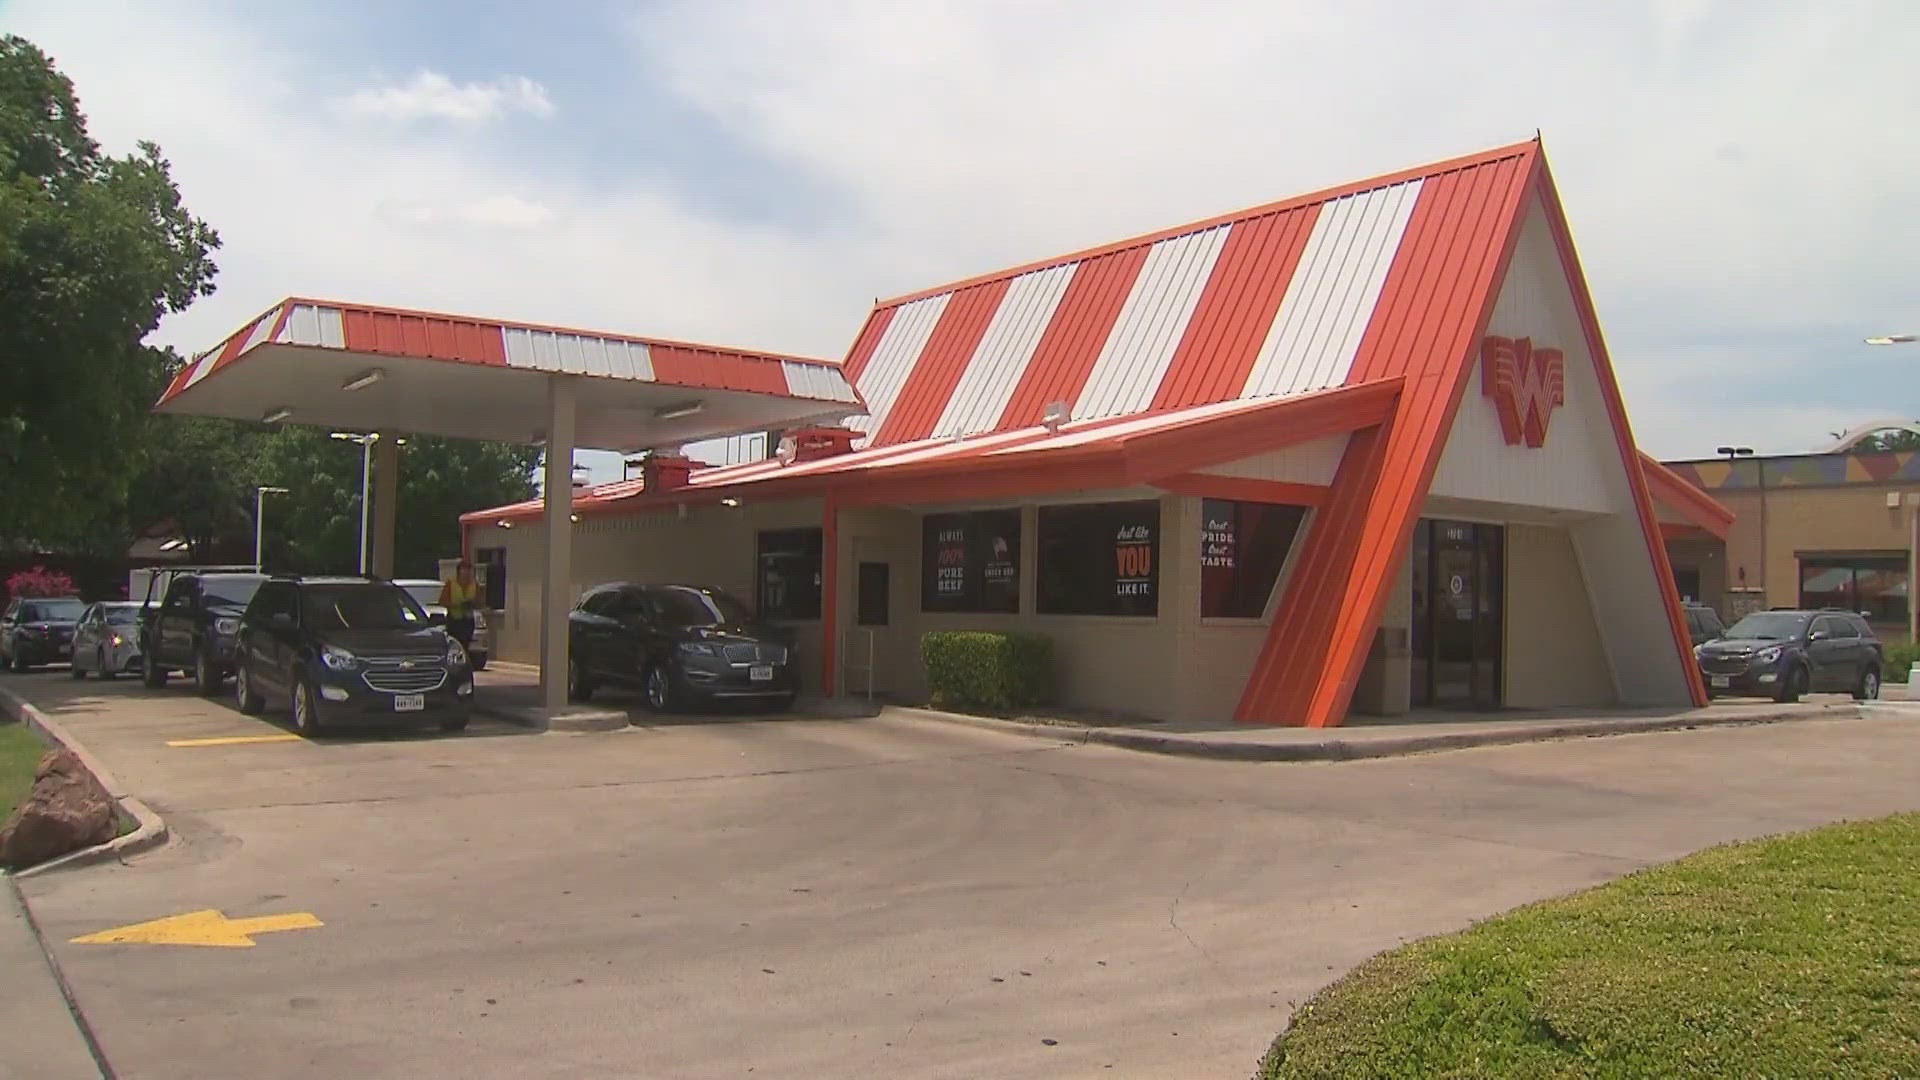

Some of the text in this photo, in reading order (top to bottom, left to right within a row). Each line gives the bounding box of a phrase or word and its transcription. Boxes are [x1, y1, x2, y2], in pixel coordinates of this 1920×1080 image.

[1481, 335, 1564, 449] W
[938, 528, 963, 543] ALWAYS
[938, 548, 964, 566] 100%
[1116, 546, 1151, 578] YOU
[938, 567, 963, 578] PURE
[938, 579, 963, 592] BEEF
[1117, 583, 1149, 594] LIKE IT.
